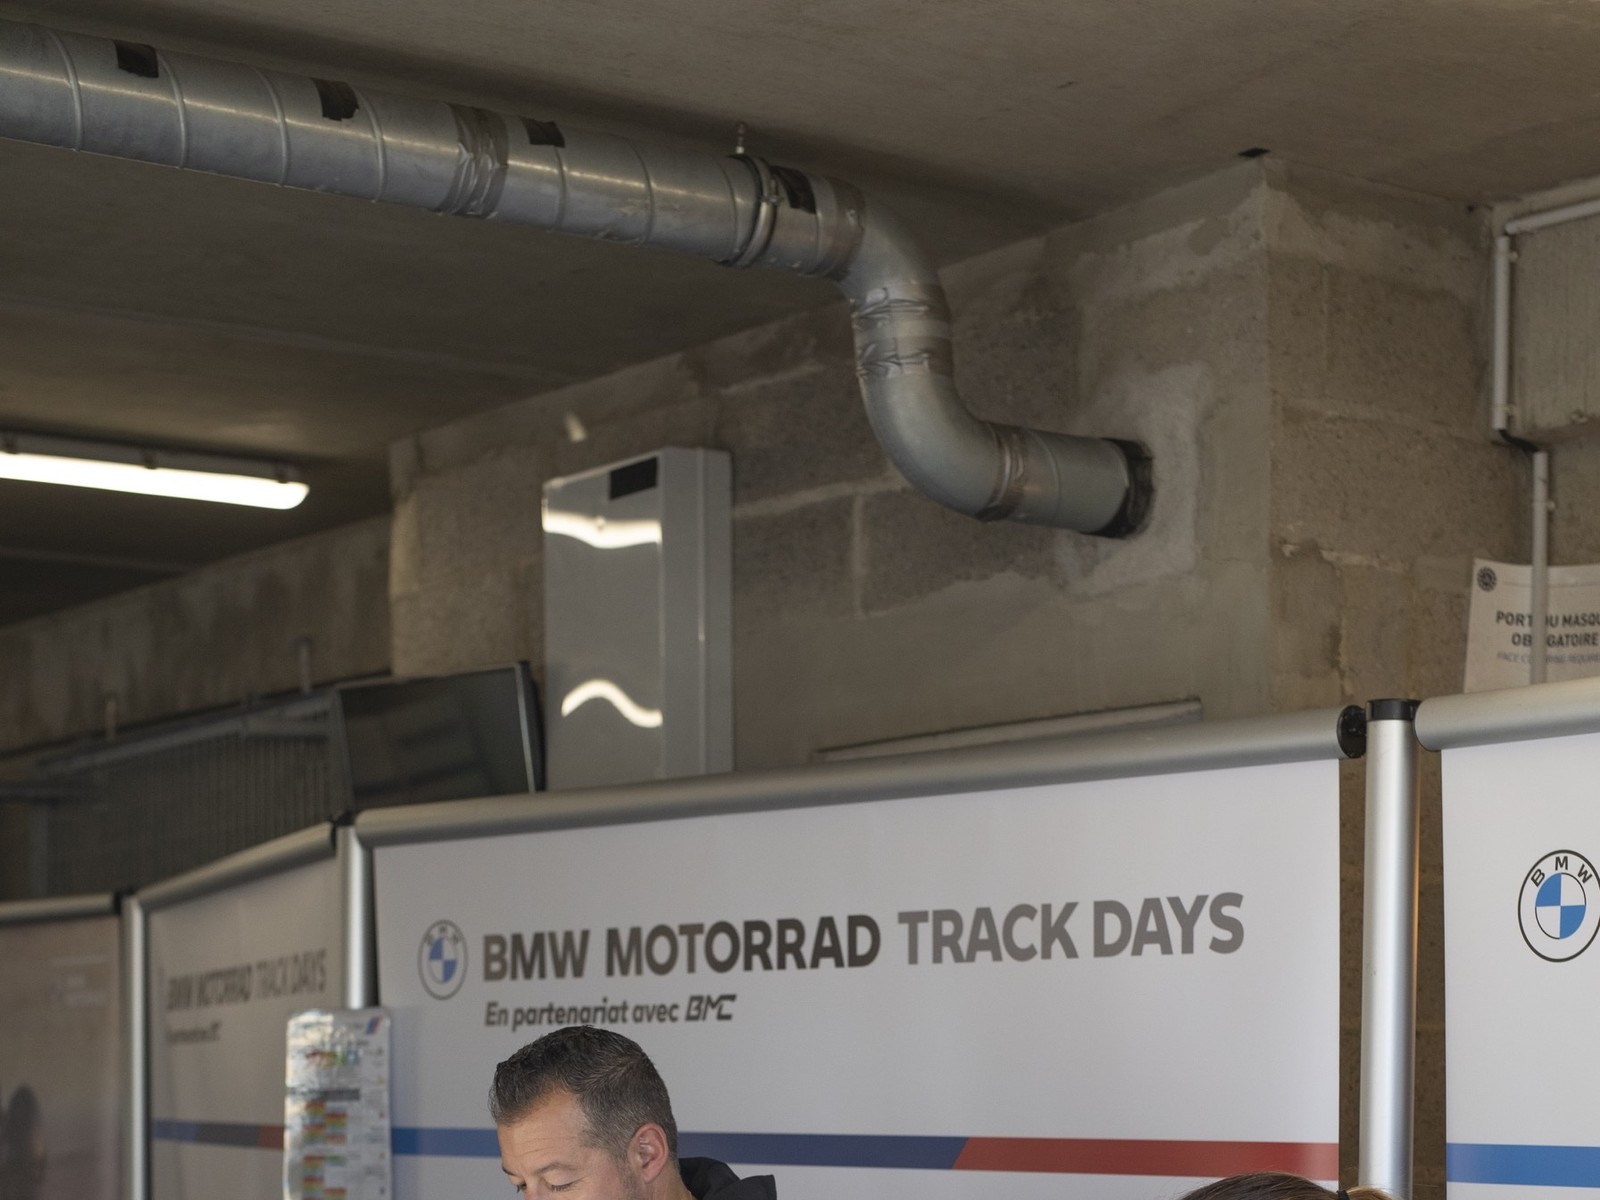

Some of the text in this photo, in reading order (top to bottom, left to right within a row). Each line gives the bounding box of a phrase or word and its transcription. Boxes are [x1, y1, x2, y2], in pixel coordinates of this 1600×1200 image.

[1496, 611, 1533, 627] PORT
[1511, 632, 1599, 648] OBGATOIRE
[1531, 855, 1593, 888] BMW
[483, 892, 1245, 982] BMW MOTORRAD TRACK DAYS
[485, 1001, 509, 1027] En
[511, 996, 629, 1033] partenariat
[633, 1002, 679, 1023] avec
